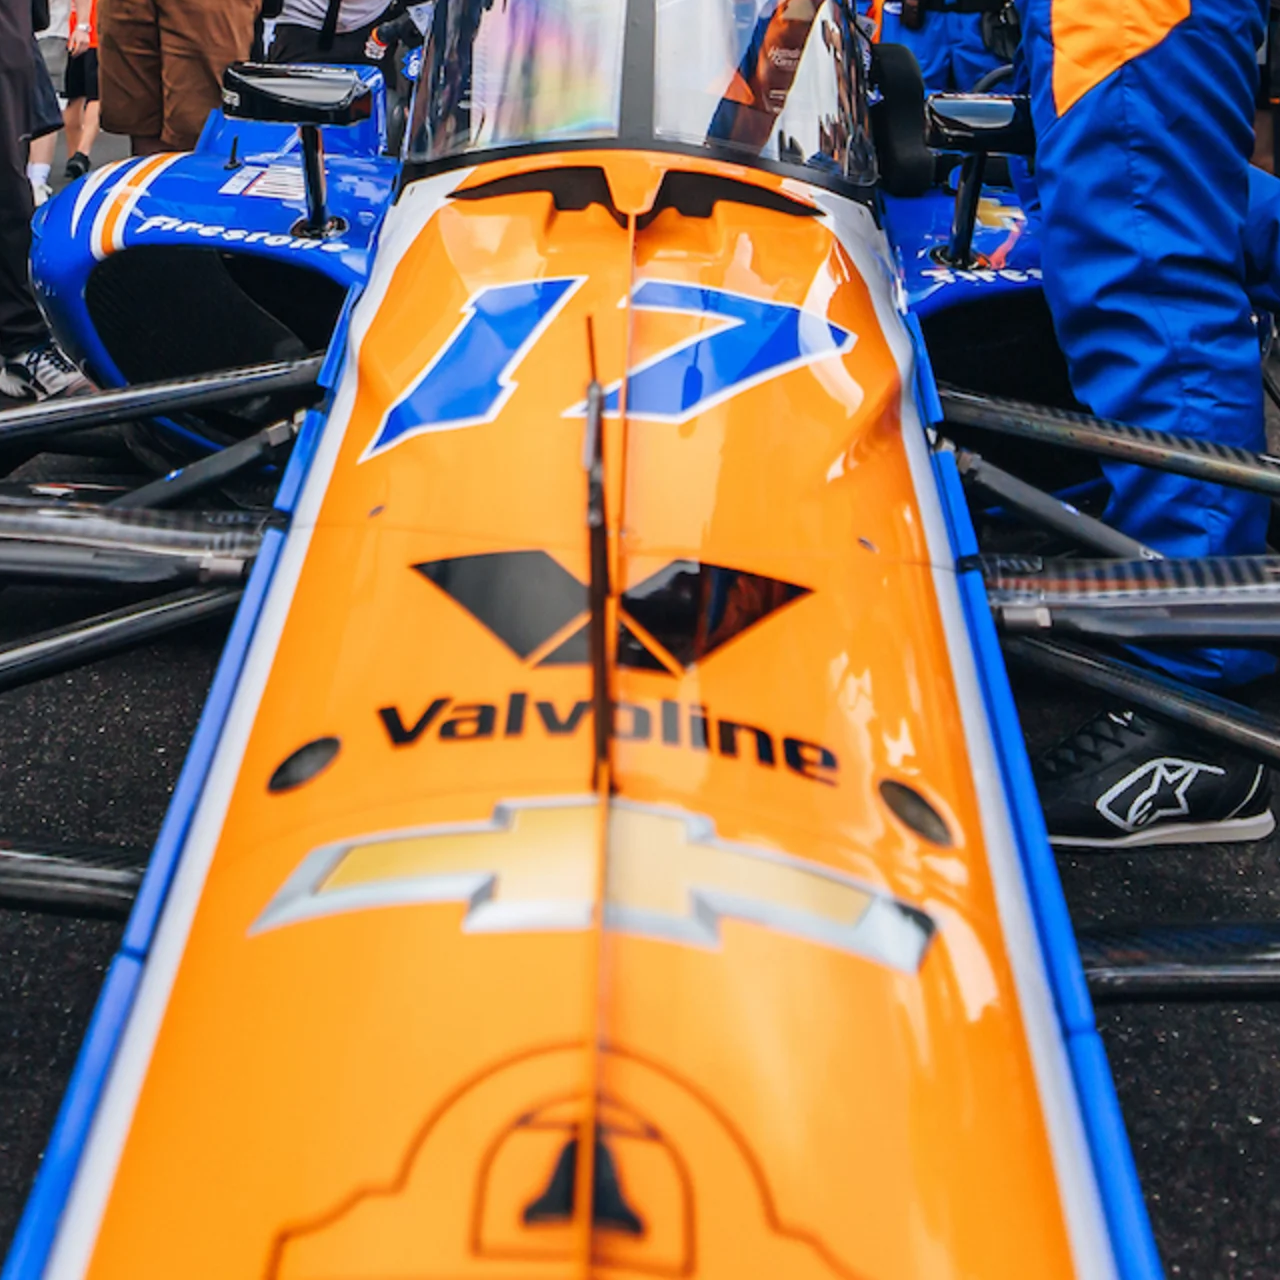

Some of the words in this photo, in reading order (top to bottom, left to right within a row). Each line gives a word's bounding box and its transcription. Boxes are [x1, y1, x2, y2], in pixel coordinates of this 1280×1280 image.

[135, 216, 350, 253] Firestone
[357, 275, 859, 465] 17
[378, 692, 840, 787] Valvoline
